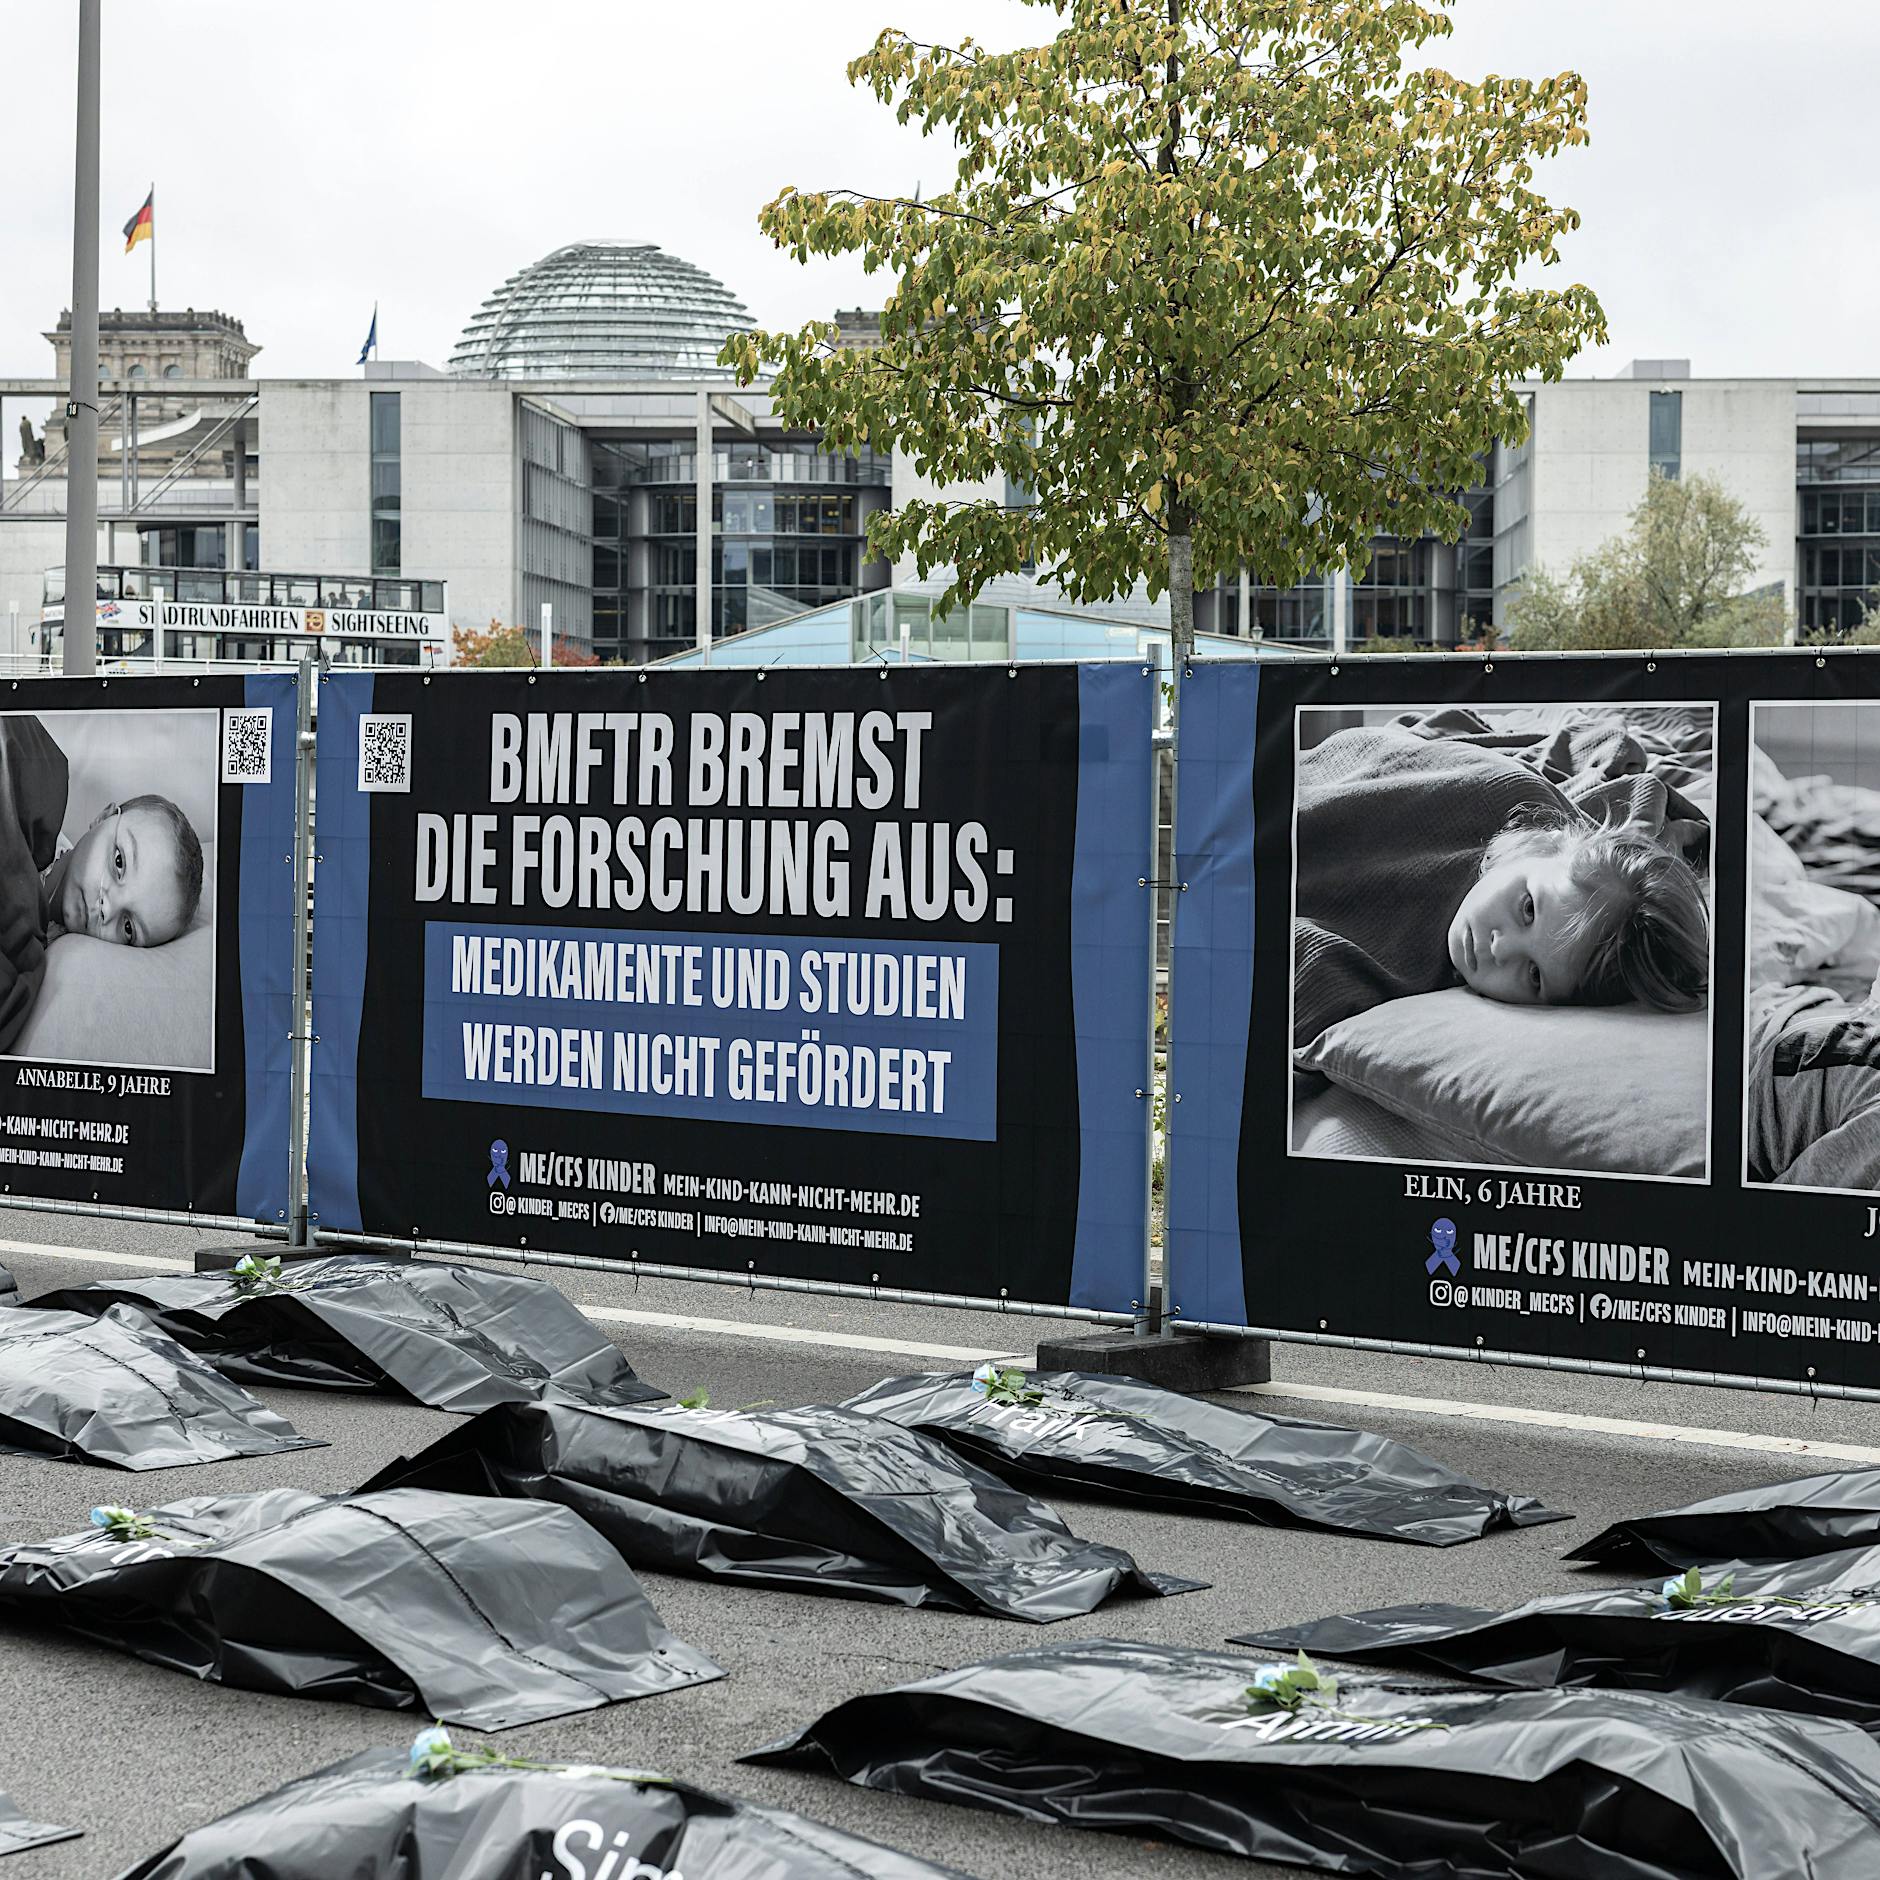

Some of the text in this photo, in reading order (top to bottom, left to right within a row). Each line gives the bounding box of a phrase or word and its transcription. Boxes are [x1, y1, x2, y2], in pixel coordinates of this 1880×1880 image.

[331, 612, 429, 635] SIGHTSEEING
[491, 711, 932, 809] BMFTR BREMST
[415, 813, 1014, 922] DIE FORSCHUNG AUS:
[452, 935, 966, 1020] MEDIKAMENTE UND STUDIEN
[16, 1068, 171, 1097] ANNABELLE, 9 JAHRE
[462, 1022, 952, 1114] WERDEN NICHT GEFÖRDERT
[0, 1115, 129, 1145] -KANN-NICHT-MEHR.DE
[519, 1152, 921, 1218] ME/CFS KINDER MEIN-KIND-KANN-NICHT-MEHR.DE
[1403, 1174, 1582, 1209] ELIN, 6 JAHRE
[657, 1210, 694, 1231] KINDER
[704, 1214, 913, 1252] INFO@MEIN-KIND-KANN-NICHT-MEHR.DE
[1863, 1206, 1880, 1238] J
[1473, 1232, 1880, 1302] ME/CFS KINDER MEIN-KIND-KANN-
[1674, 1304, 1727, 1329] KINDER
[1742, 1310, 1880, 1344] INFO@MEIN-KIND-
